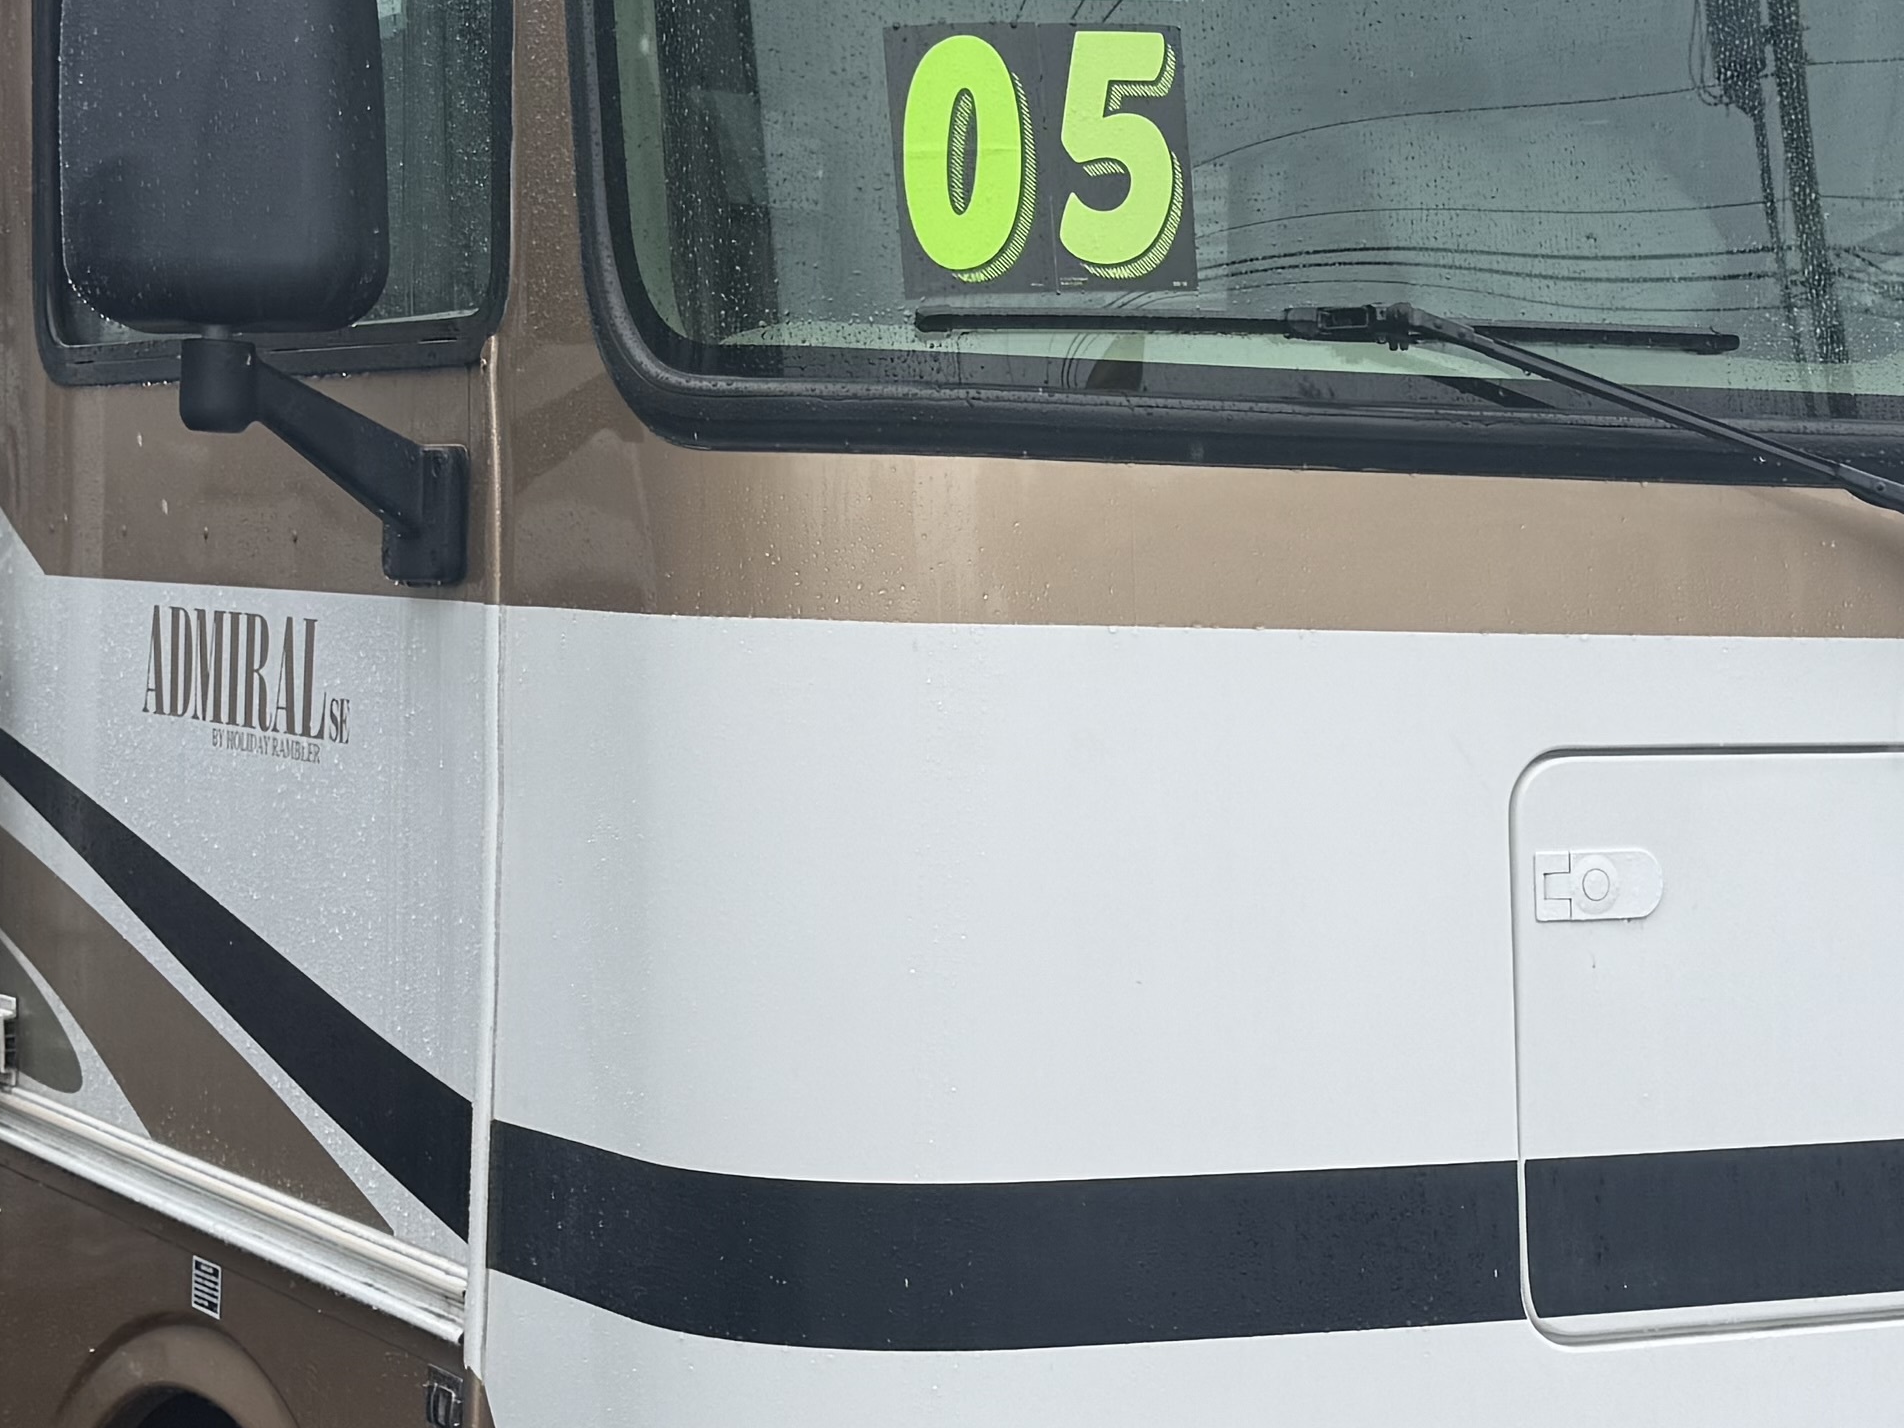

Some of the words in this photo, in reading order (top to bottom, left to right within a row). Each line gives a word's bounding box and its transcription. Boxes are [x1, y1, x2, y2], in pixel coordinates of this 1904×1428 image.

[903, 31, 1184, 283] 05
[142, 604, 327, 740] ADMIRAL
[329, 698, 350, 744] SE
[212, 728, 225, 748] BY
[226, 730, 271, 755] HOLIDAY
[271, 737, 321, 765] RAMBLER
